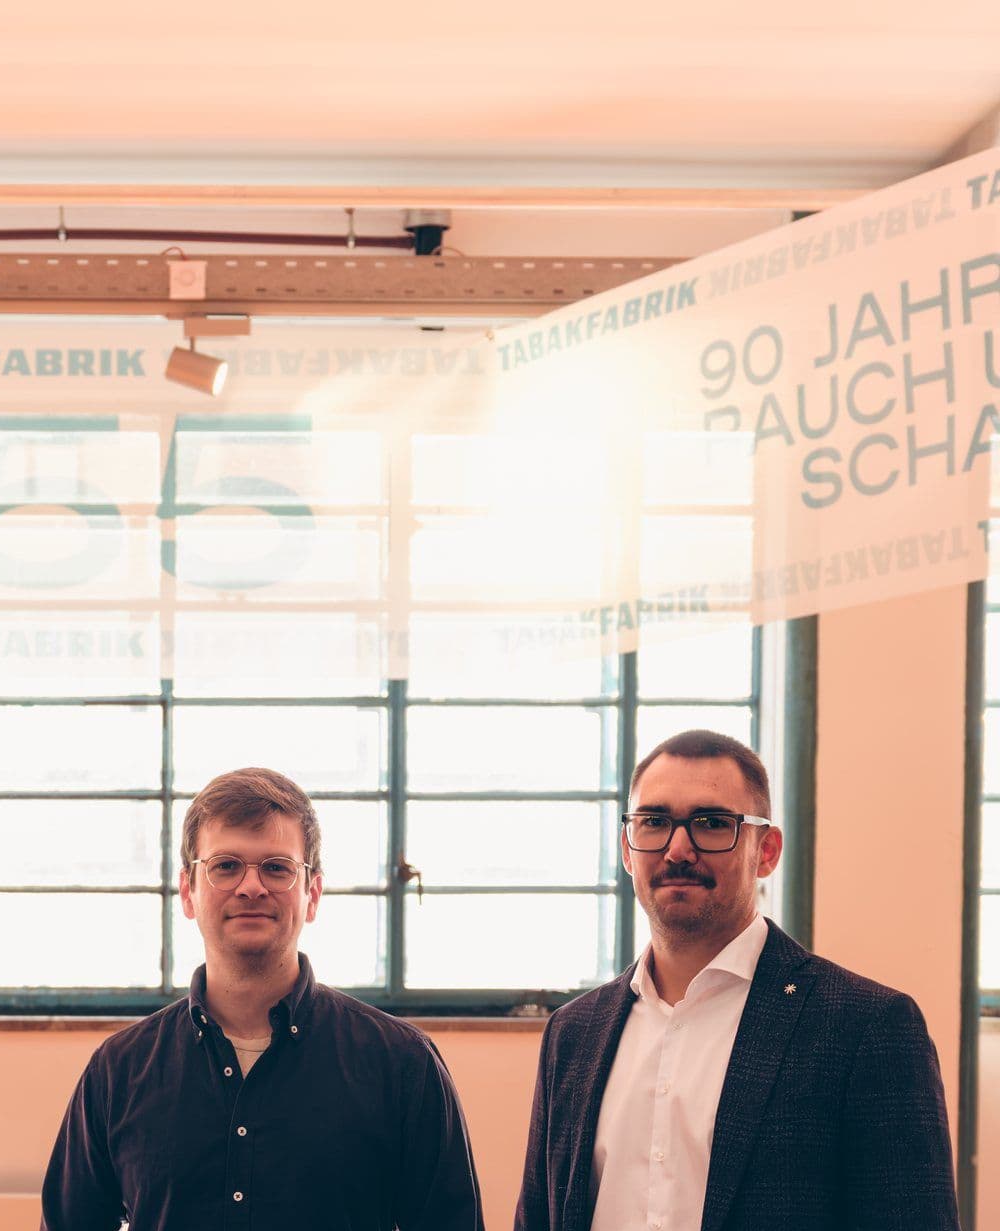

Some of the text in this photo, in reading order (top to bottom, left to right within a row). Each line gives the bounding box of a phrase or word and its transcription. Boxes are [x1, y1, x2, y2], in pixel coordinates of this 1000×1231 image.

[707, 193, 957, 298] TABAKFABRIK
[499, 279, 698, 371] TABAKFABRIK
[700, 325, 784, 399] 90
